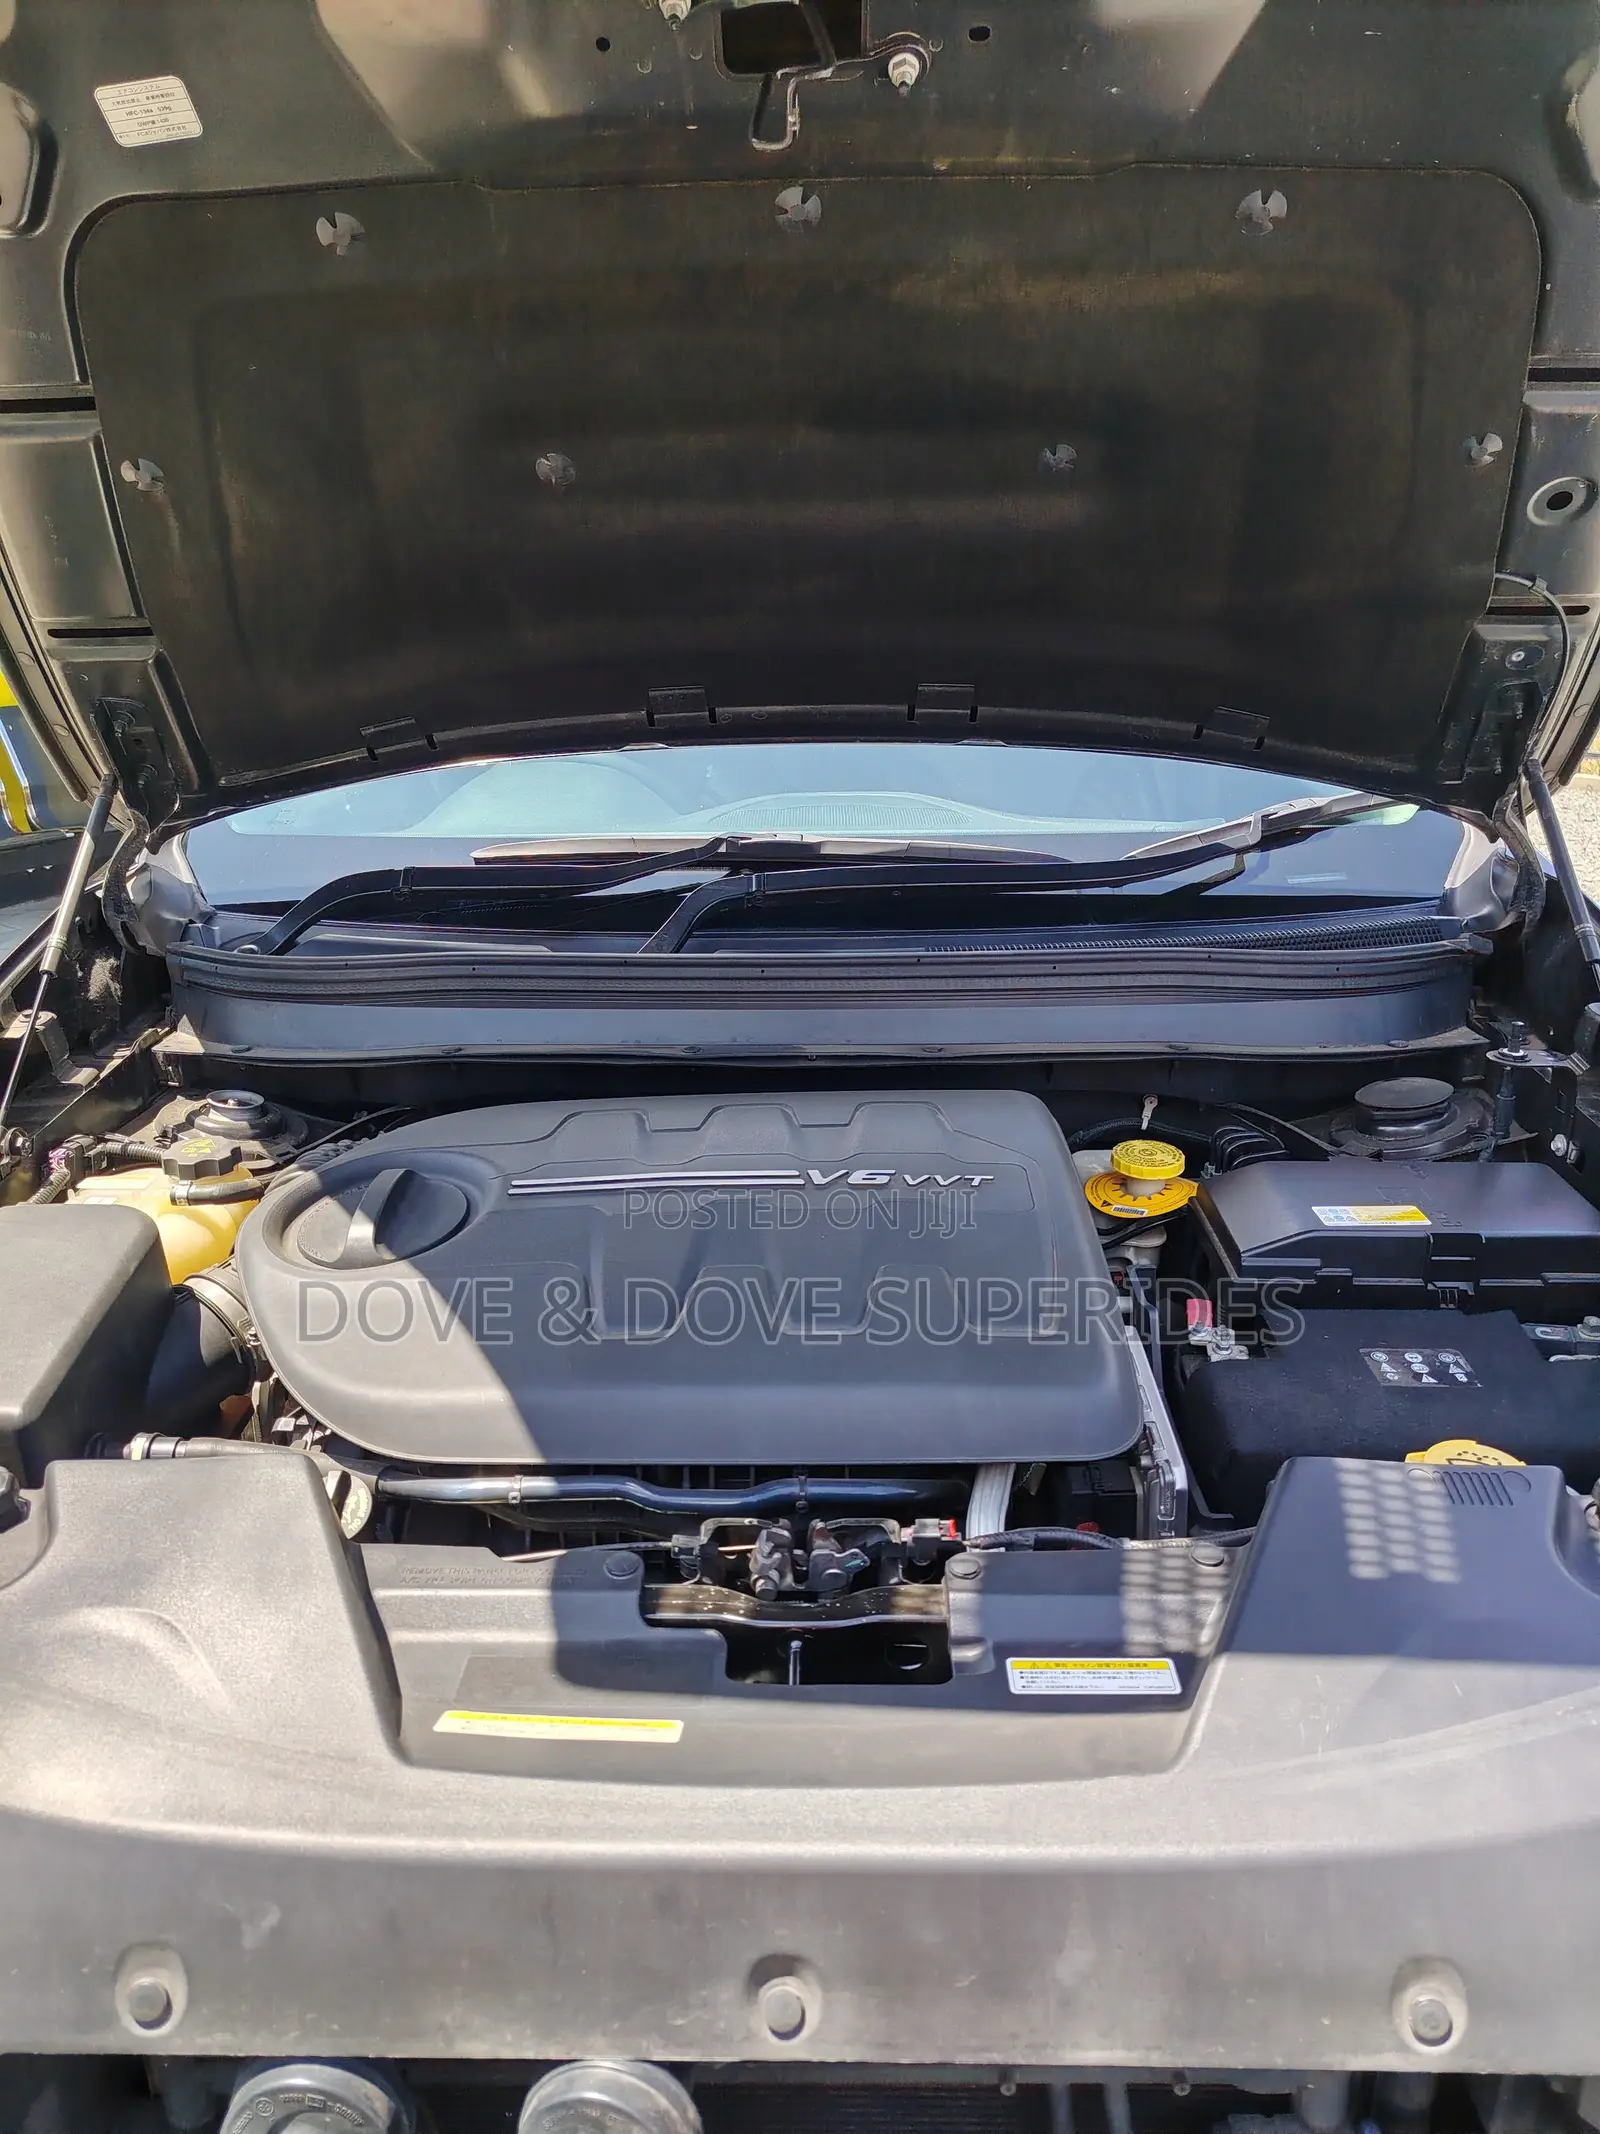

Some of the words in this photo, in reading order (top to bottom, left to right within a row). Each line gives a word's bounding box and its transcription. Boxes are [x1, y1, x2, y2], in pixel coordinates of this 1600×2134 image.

[806, 1169, 896, 1187] V6
[903, 1174, 994, 1187] VVT
[448, 1567, 471, 1575] THIS
